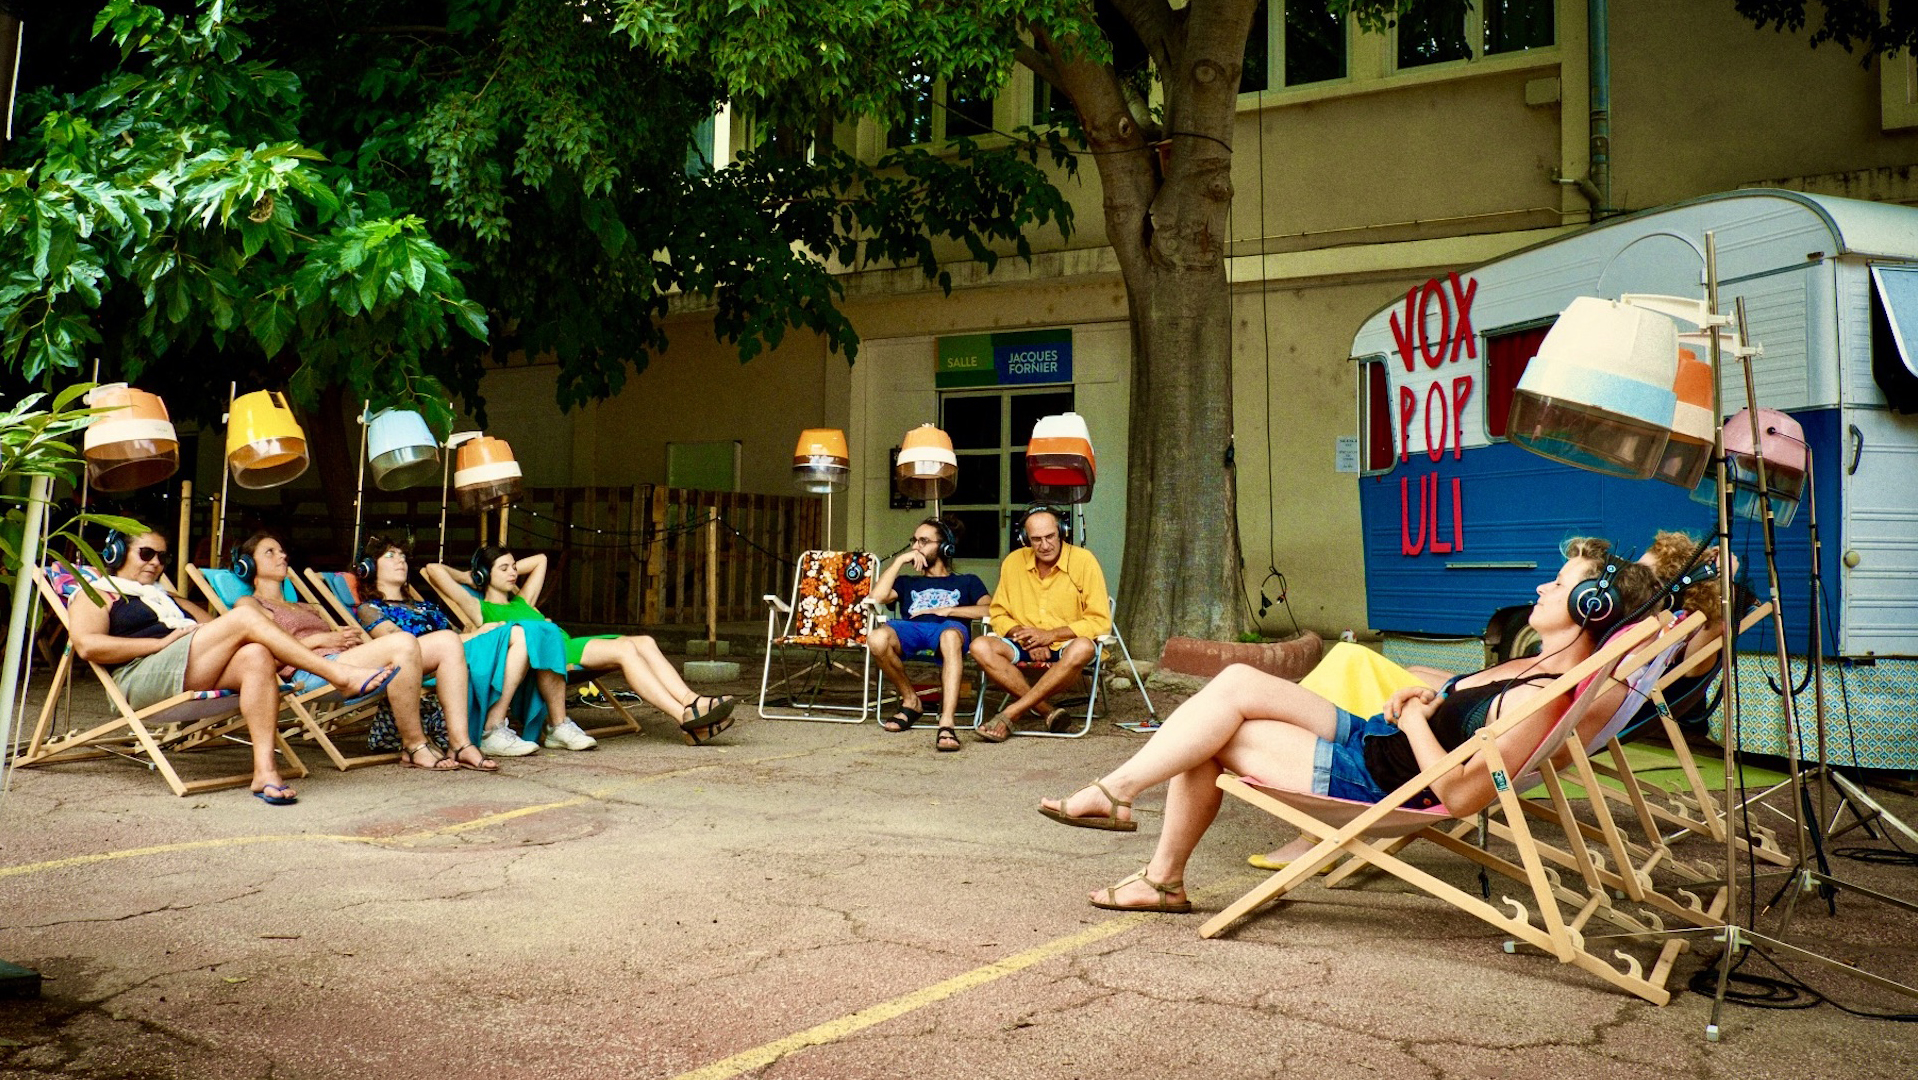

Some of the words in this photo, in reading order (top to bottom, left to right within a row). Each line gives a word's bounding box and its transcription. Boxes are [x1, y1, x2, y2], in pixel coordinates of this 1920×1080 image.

[1389, 271, 1477, 372] VOX
[947, 356, 978, 368] SALLE
[1008, 350, 1058, 363] JACQUES
[1008, 362, 1058, 374] FORNIER
[1400, 375, 1473, 464] POP
[1401, 471, 1464, 556] ULI
